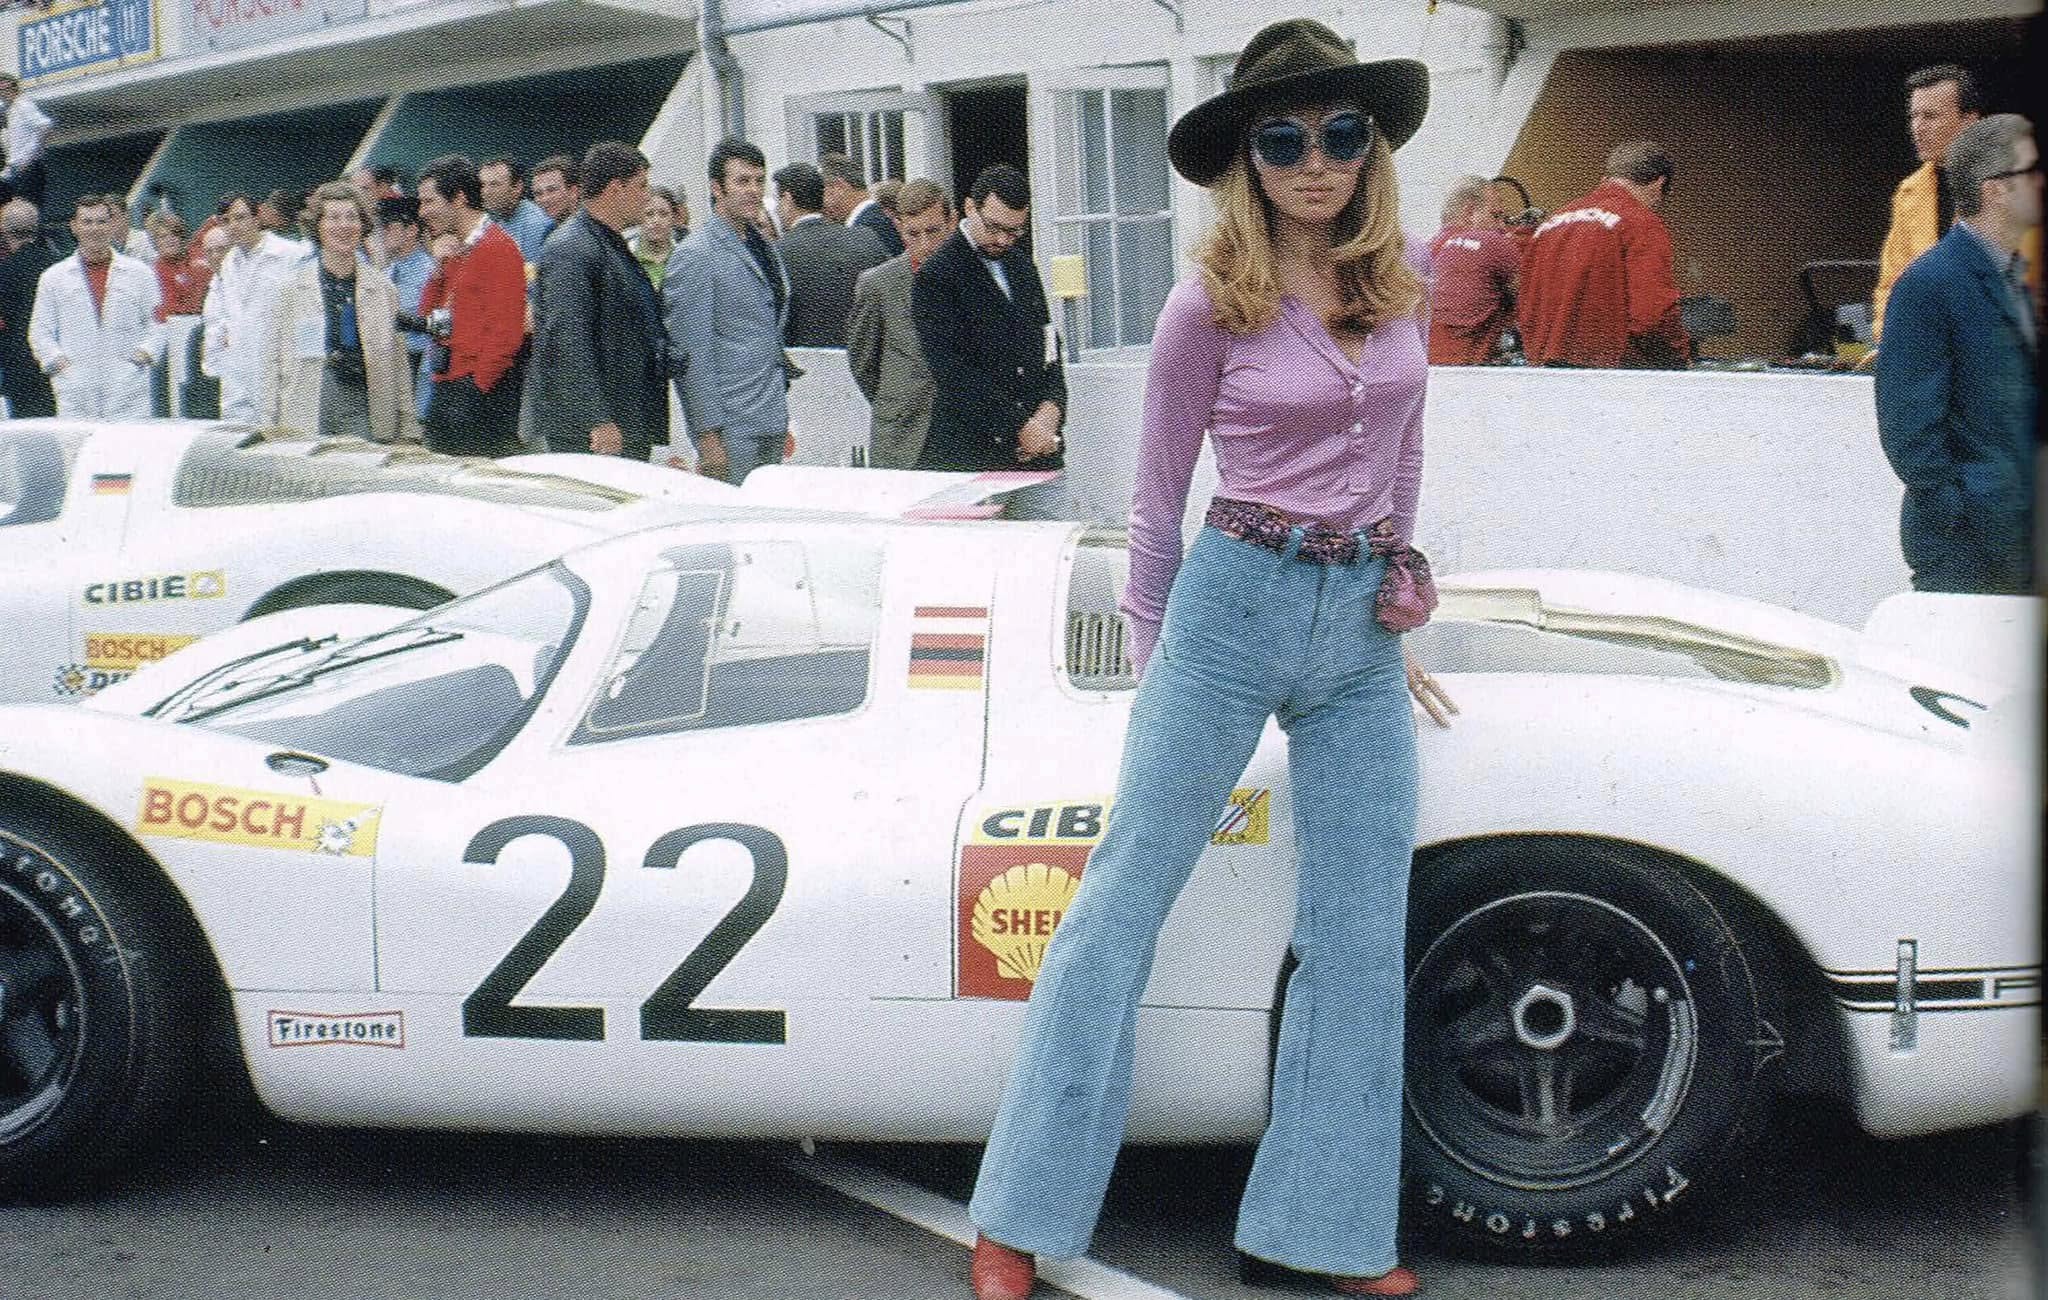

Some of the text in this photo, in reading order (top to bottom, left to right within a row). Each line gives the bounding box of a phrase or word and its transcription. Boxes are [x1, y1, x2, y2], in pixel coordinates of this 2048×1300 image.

[25, 7, 111, 71] PORSCHE
[86, 639, 166, 659] BOSCH
[143, 787, 307, 839] BOSCH
[982, 804, 1103, 838] CIB
[461, 814, 789, 1045] 22
[991, 908, 1061, 937] SHE
[276, 1018, 396, 1040] Firestone
